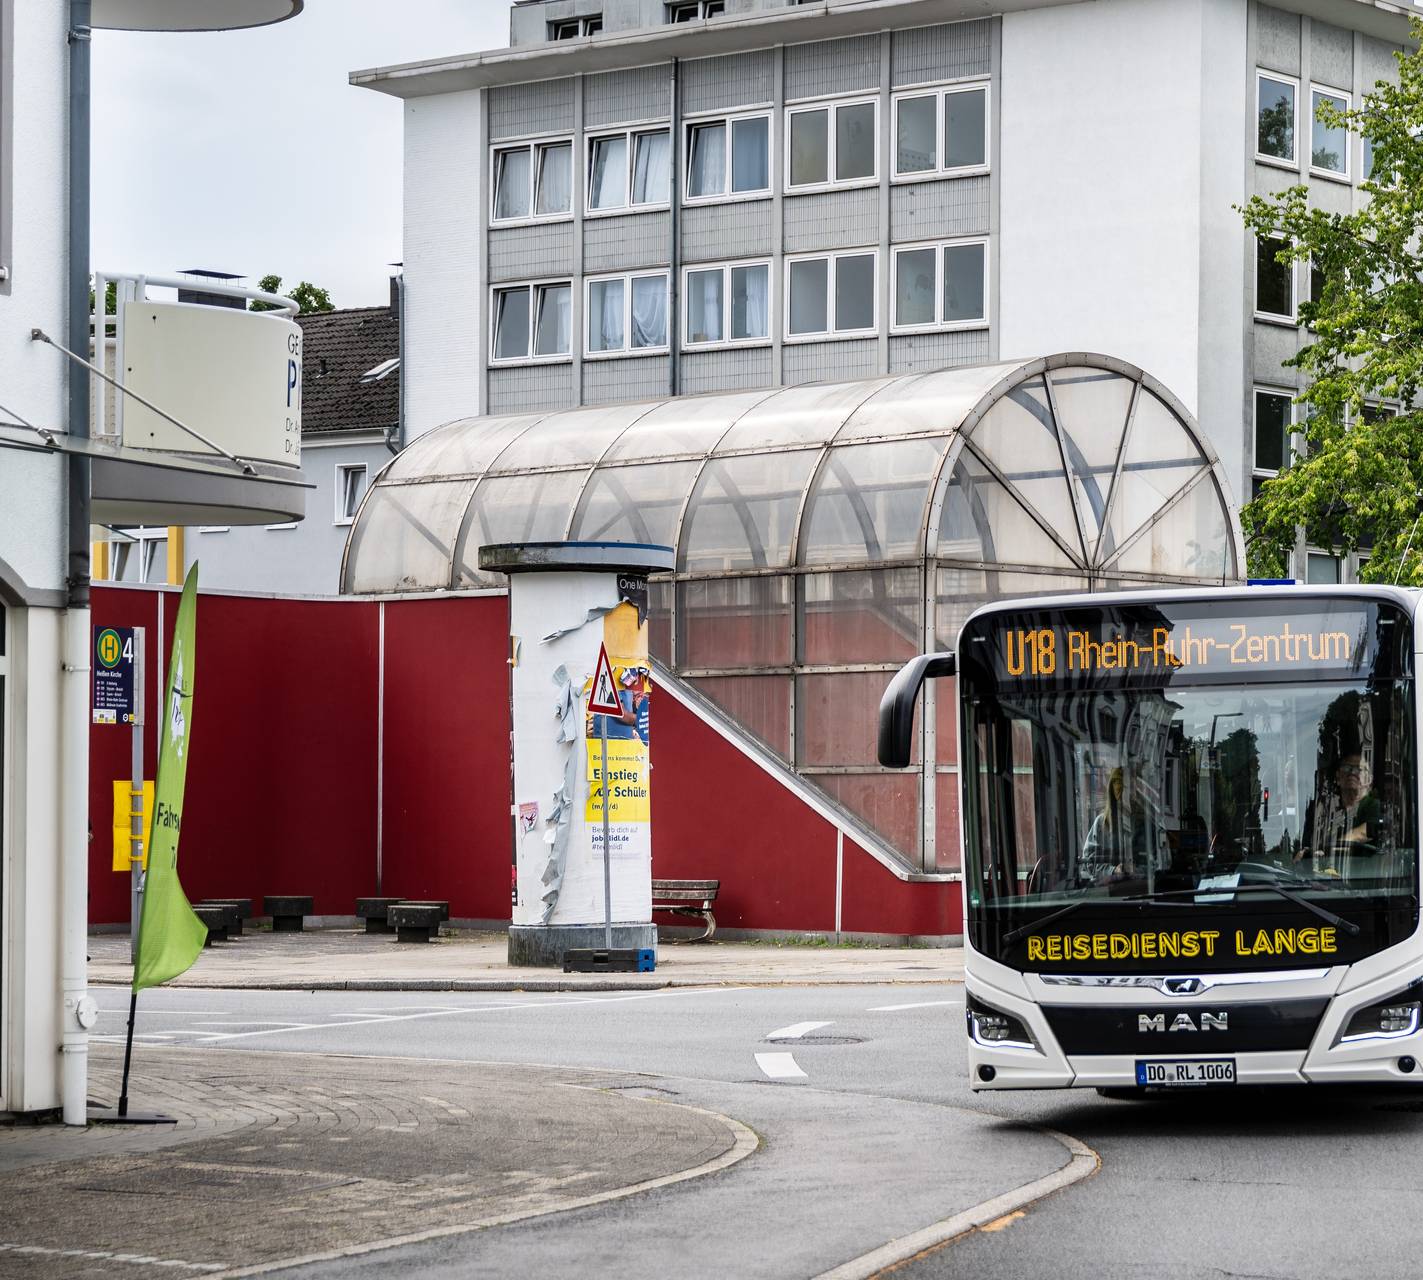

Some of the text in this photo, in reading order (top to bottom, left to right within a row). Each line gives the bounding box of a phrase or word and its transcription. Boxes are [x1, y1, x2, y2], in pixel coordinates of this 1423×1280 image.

[619, 578, 636, 590] One
[105, 637, 133, 663] H 4
[1006, 622, 1350, 676] U18 Rhein-Ruhr-Zentrum
[614, 785, 647, 797] Schüler
[592, 803, 618, 811] (m//d)
[1027, 926, 1338, 961] REISEDIENST LANGE
[1138, 1011, 1229, 1032] MAN
[1147, 1065, 1166, 1081] DO
[1176, 1064, 1194, 1081] RL
[1197, 1064, 1233, 1080] 1006
